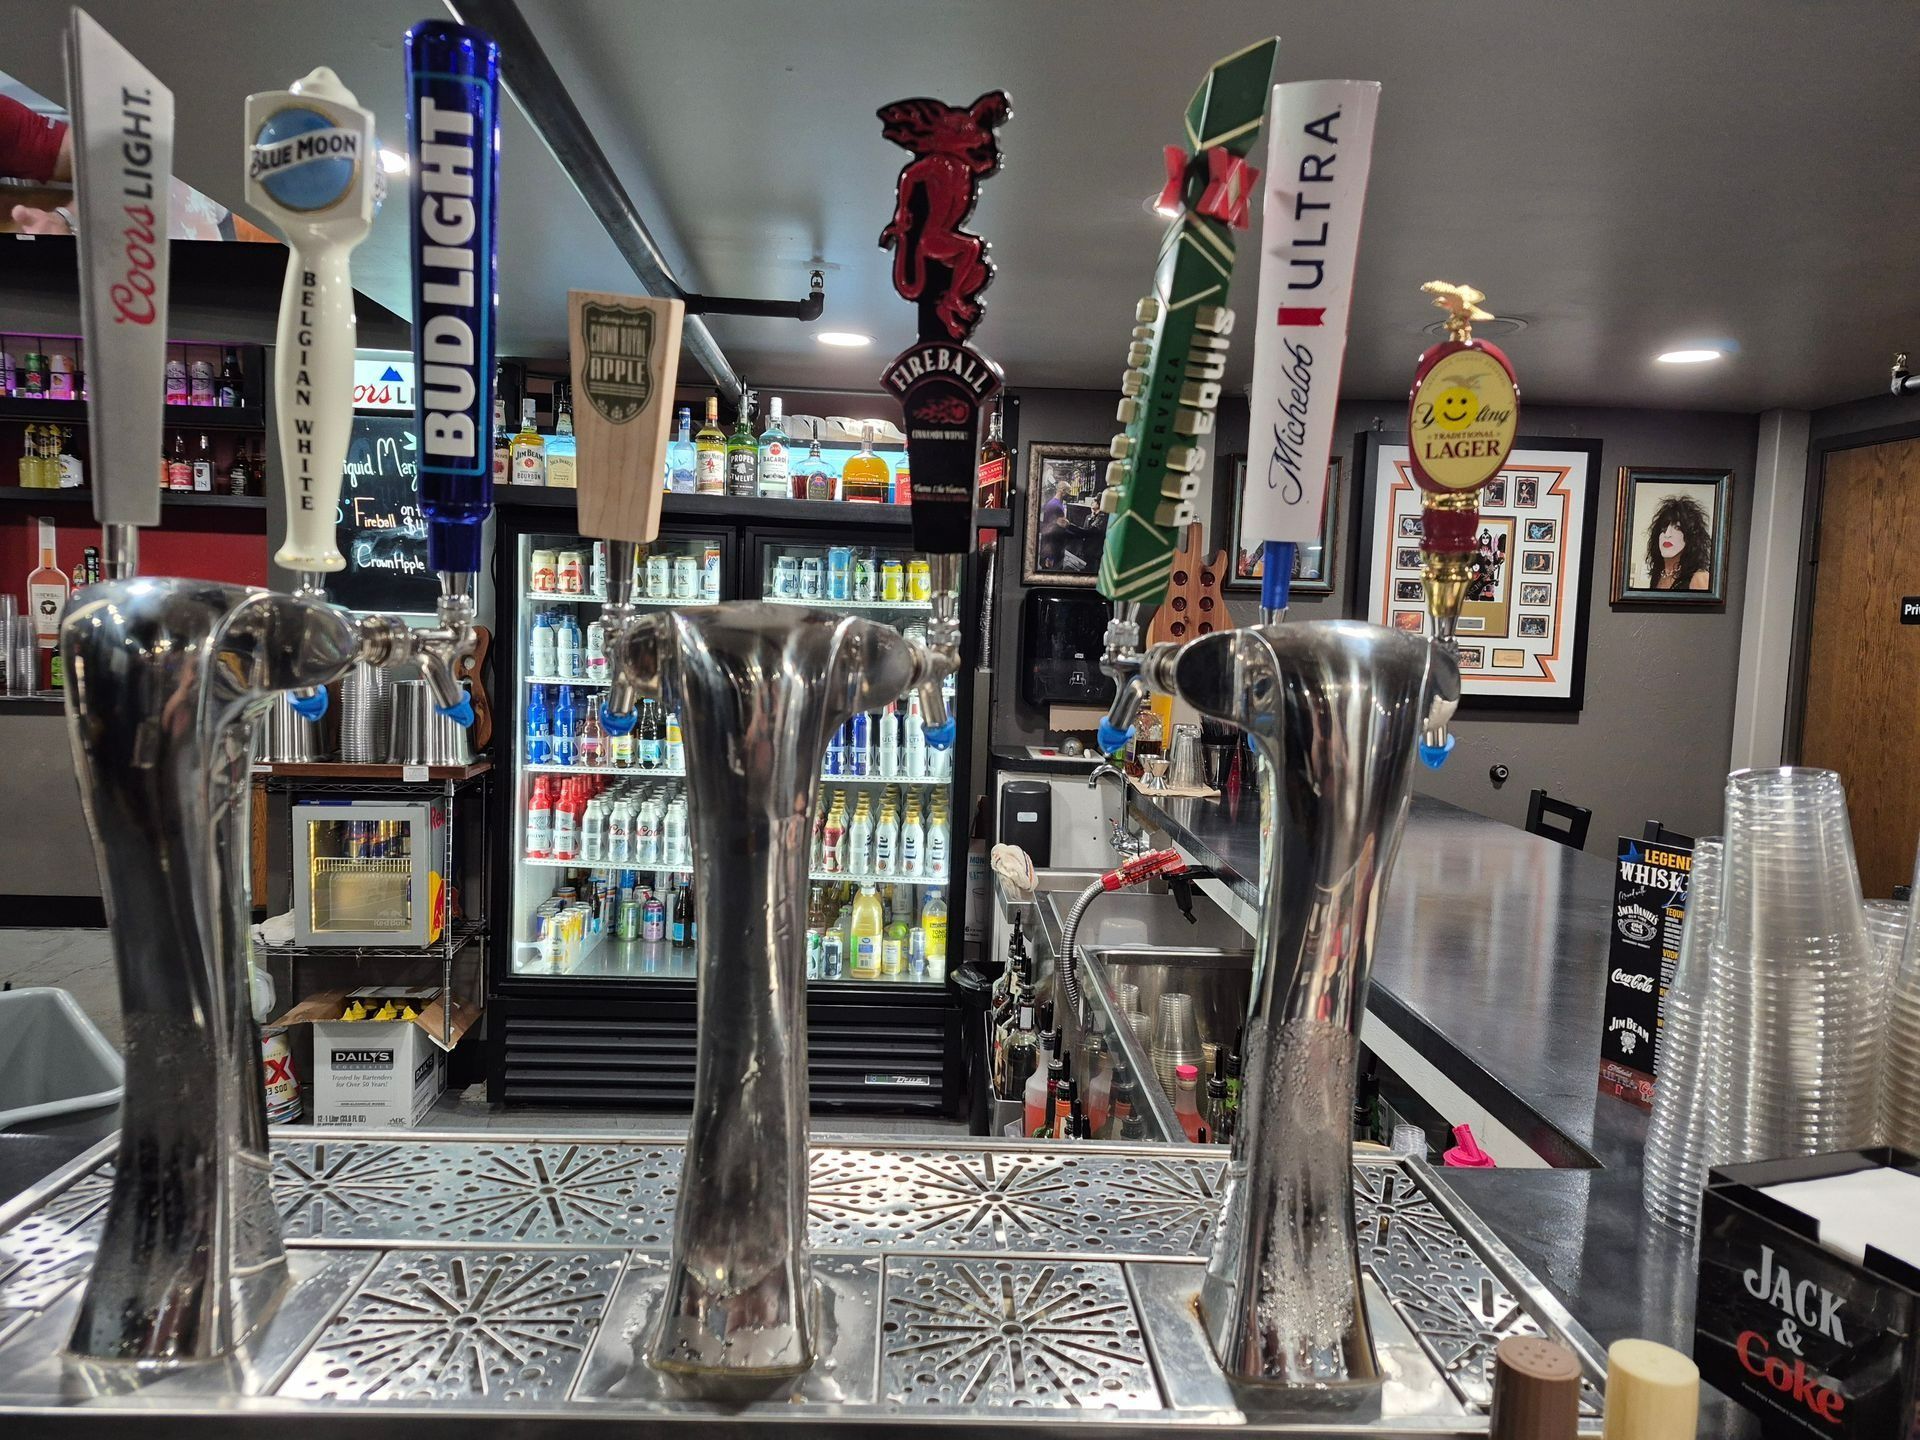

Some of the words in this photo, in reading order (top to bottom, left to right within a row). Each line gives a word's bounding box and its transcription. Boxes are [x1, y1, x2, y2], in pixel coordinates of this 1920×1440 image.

[249, 145, 292, 178] BLUE
[296, 134, 356, 160] MOON
[420, 96, 476, 307] LIGHT
[1287, 109, 1341, 291] ULTRA
[110, 204, 156, 325] Coors
[296, 271, 317, 406] BELGIAN
[423, 315, 476, 458] BUD
[590, 357, 646, 385] APPLE
[889, 348, 989, 393] FIREBALL
[1147, 357, 1181, 467] CERVEZA
[1268, 337, 1314, 506] Michelob
[516, 450, 527, 461] JIM
[527, 448, 543, 461] BEAM
[1425, 440, 1501, 460] LAGER
[1433, 431, 1495, 441] TRADITIONAL
[295, 419, 314, 511] WHITE
[517, 472, 541, 480] BOURBON
[730, 454, 754, 465] PROPER
[731, 473, 755, 482] TWELVE
[355, 498, 396, 528] Fireball
[1617, 905, 1634, 917] JACK
[1609, 1016, 1626, 1032] JIM
[1626, 1017, 1649, 1044] BEAM
[1743, 1244, 1851, 1347] JACK
[1776, 1318, 1805, 1356] &
[1736, 1330, 1845, 1424] Coke
